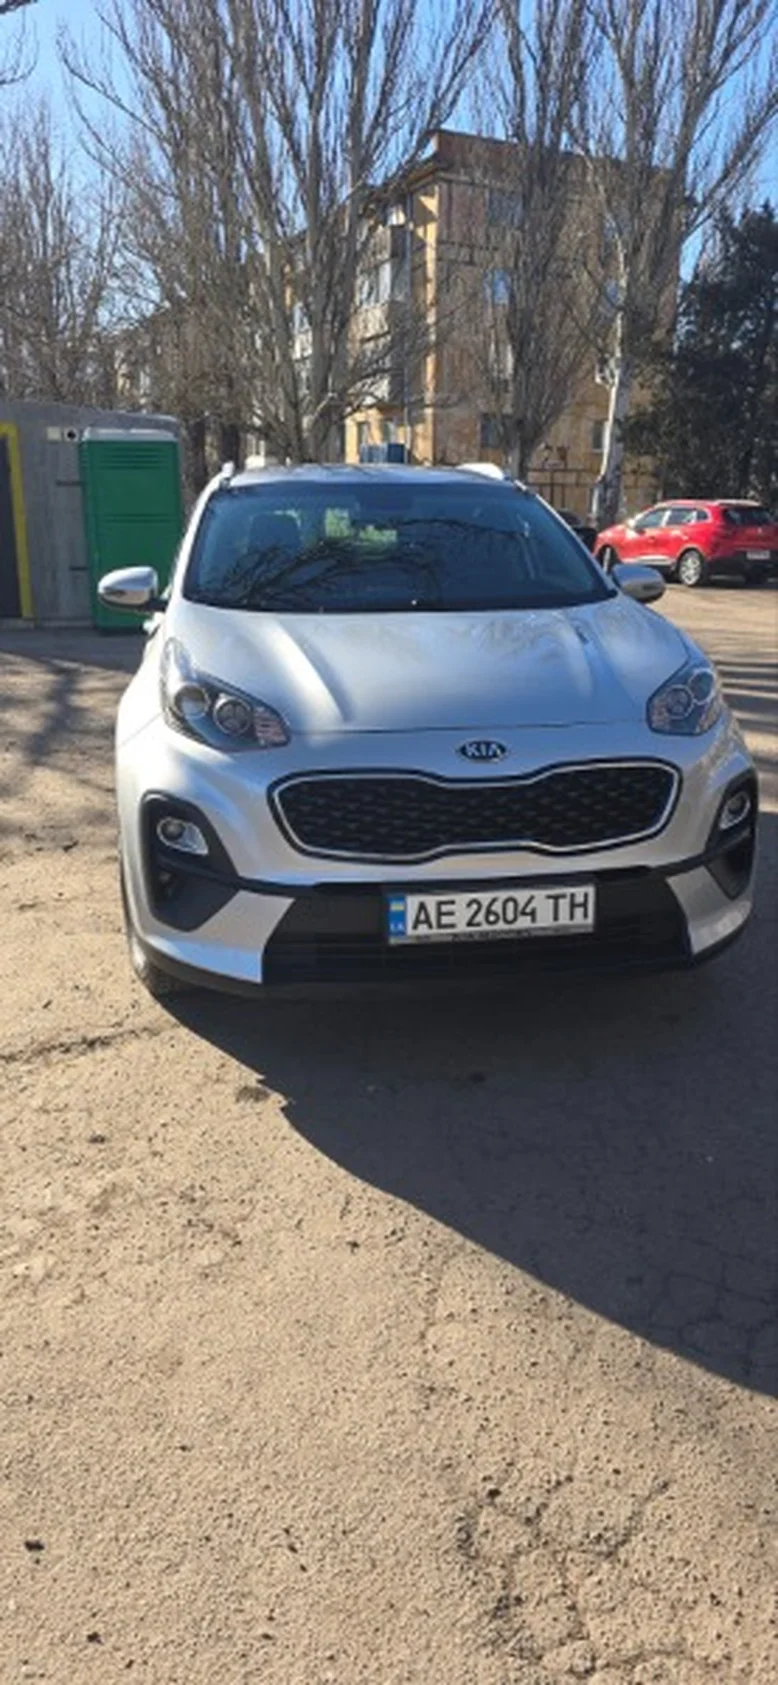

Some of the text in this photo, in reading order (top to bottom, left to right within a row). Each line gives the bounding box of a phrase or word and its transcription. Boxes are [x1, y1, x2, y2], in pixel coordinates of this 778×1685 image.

[464, 742, 502, 757] KIA
[411, 891, 589, 931] AE 2604 TH
